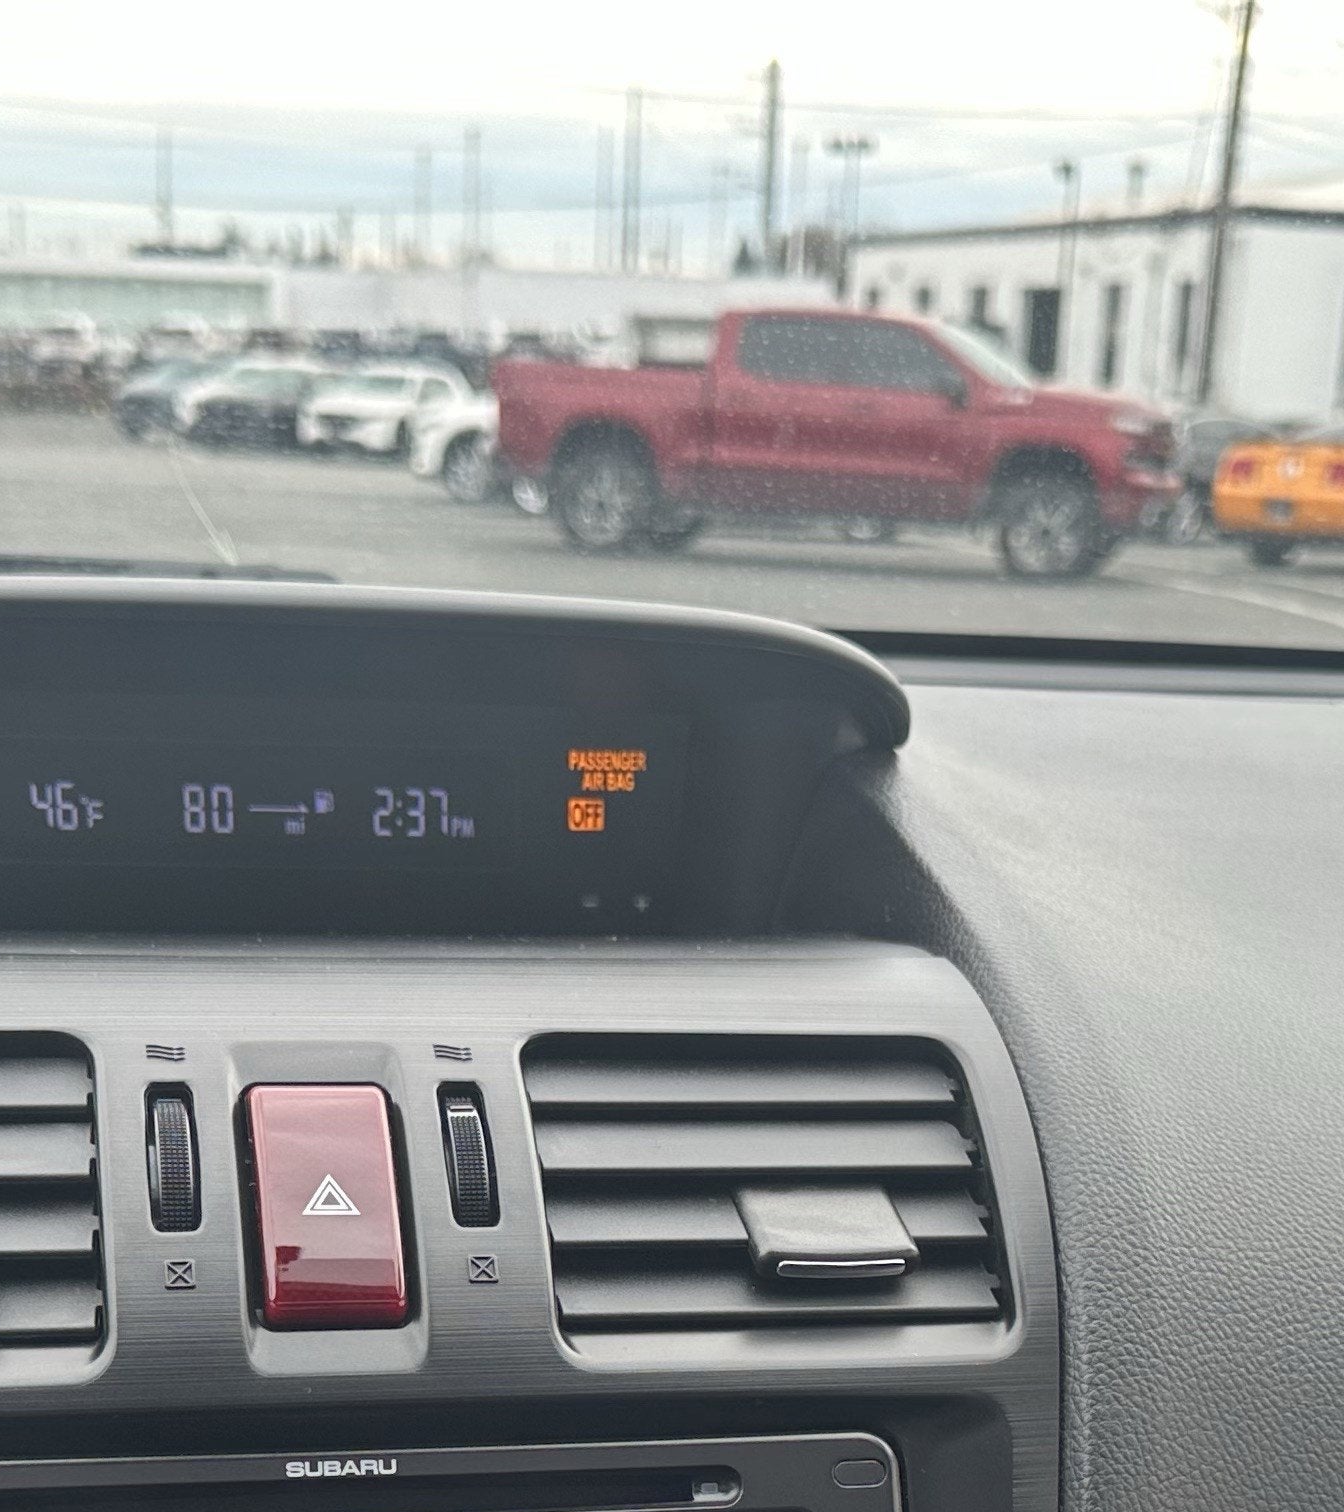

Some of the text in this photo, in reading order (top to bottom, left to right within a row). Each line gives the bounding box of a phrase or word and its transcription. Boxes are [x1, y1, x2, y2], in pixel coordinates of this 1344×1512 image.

[568, 749, 646, 771] PASSENGER
[582, 771, 635, 791] AIR BAG
[182, 783, 234, 834] 80
[372, 786, 448, 837] 2:37
[572, 802, 603, 828] OFF
[285, 1458, 397, 1478] SUBARU
